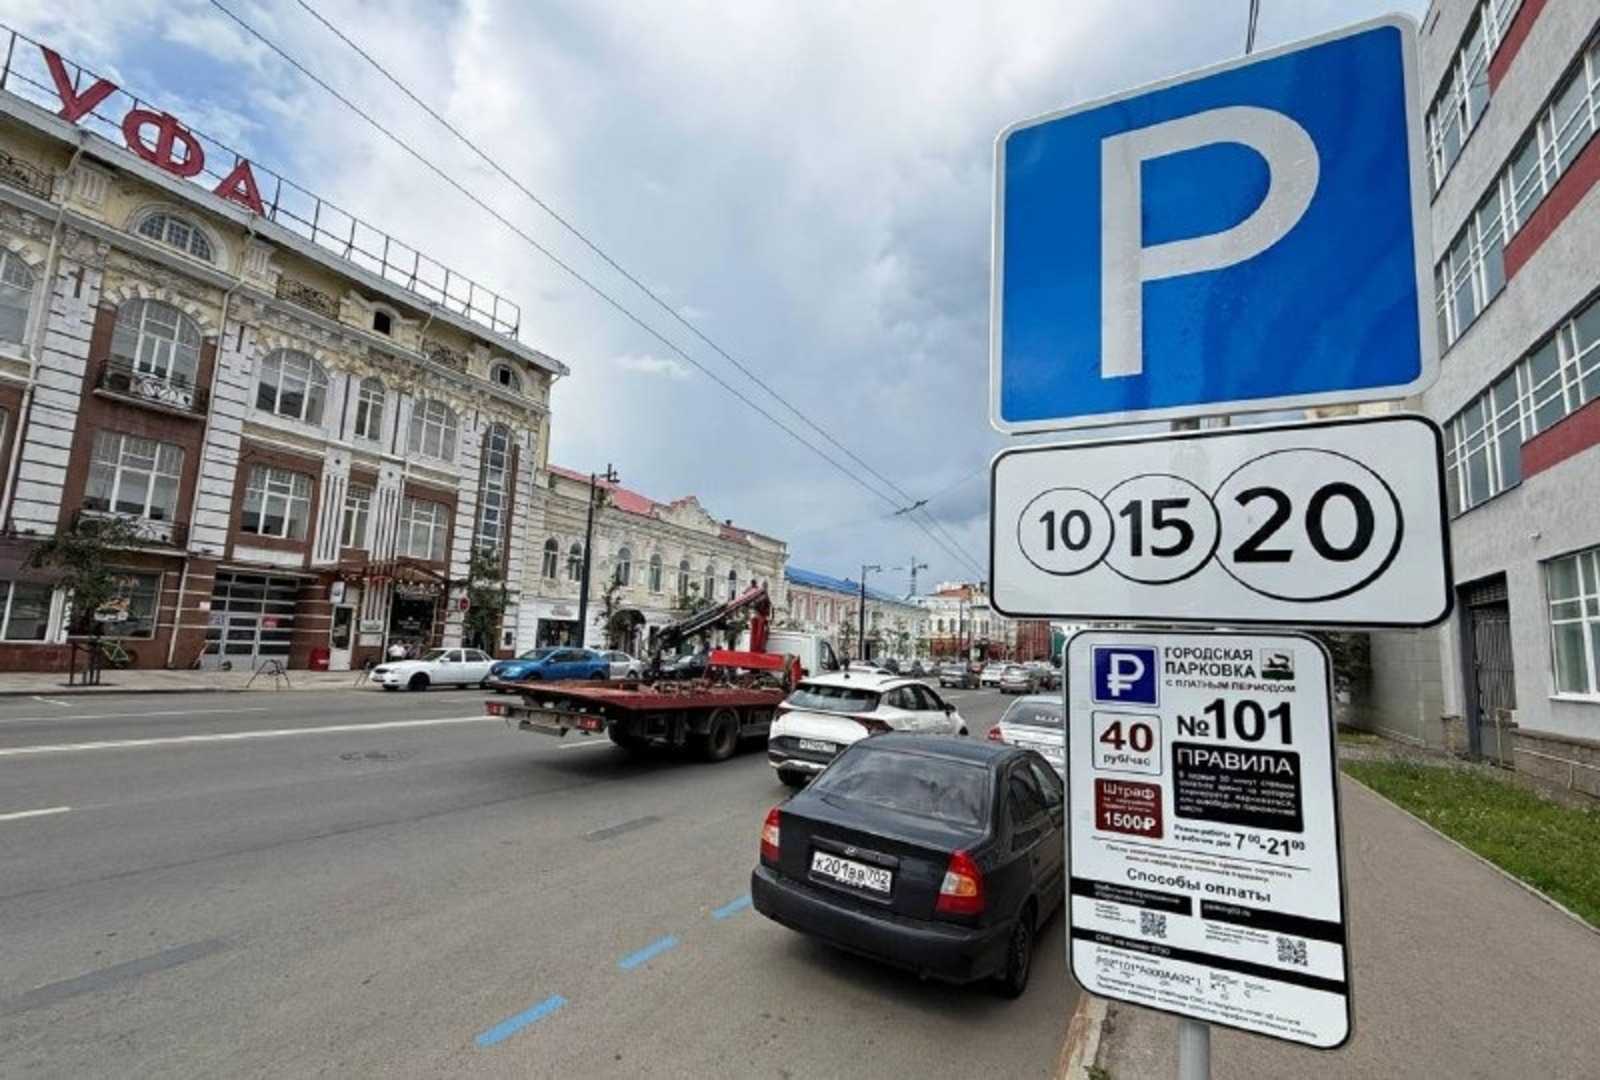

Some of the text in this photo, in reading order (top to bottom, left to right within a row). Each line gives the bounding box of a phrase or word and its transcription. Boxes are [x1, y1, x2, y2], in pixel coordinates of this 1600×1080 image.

[40, 45, 266, 217] УФА
[1039, 481, 1375, 562] 10 15 20
[1164, 647, 1253, 661] ГОРОДСКАЯ
[1164, 661, 1256, 679] ПАРКОВКА
[1099, 720, 1153, 752] 40
[1103, 754, 1151, 766] руб/час
[1177, 749, 1294, 776] ПРАВИЛА
[1103, 782, 1155, 800] Штраф
[1127, 868, 1200, 891] Способы
[1205, 882, 1271, 903] оплаты
